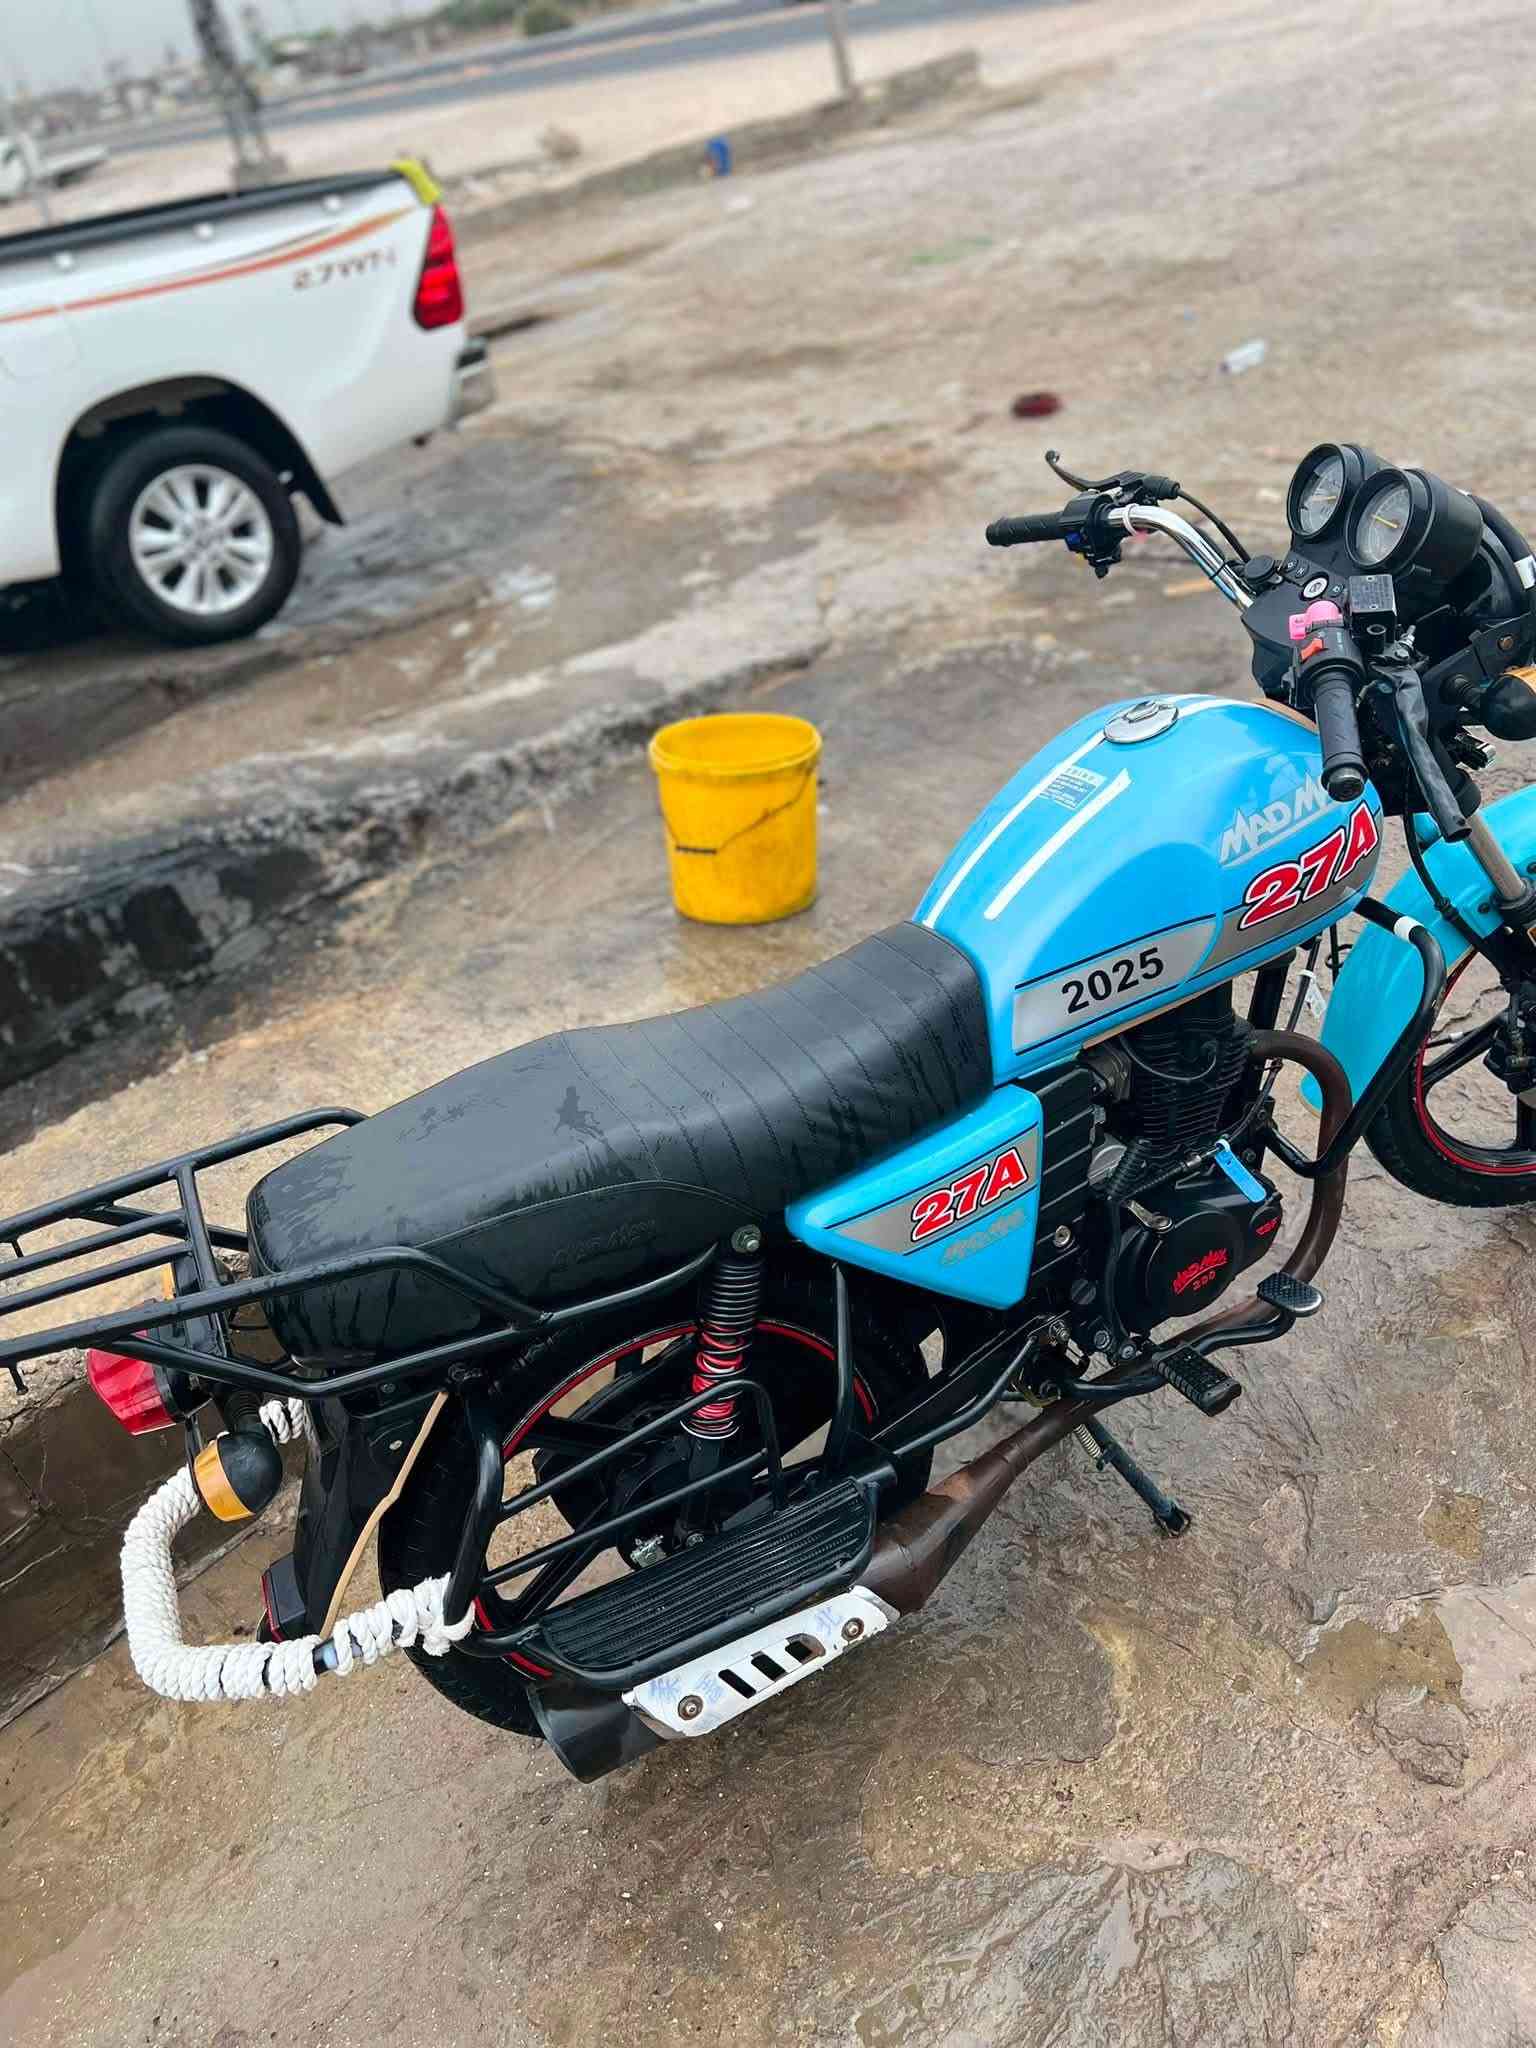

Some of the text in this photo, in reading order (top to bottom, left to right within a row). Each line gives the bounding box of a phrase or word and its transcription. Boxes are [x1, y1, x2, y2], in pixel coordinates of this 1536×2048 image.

[1219, 808, 1293, 865] MAD
[1238, 800, 1379, 930] 27A
[1061, 947, 1164, 1014] 2025
[911, 1147, 1029, 1242] 27A
